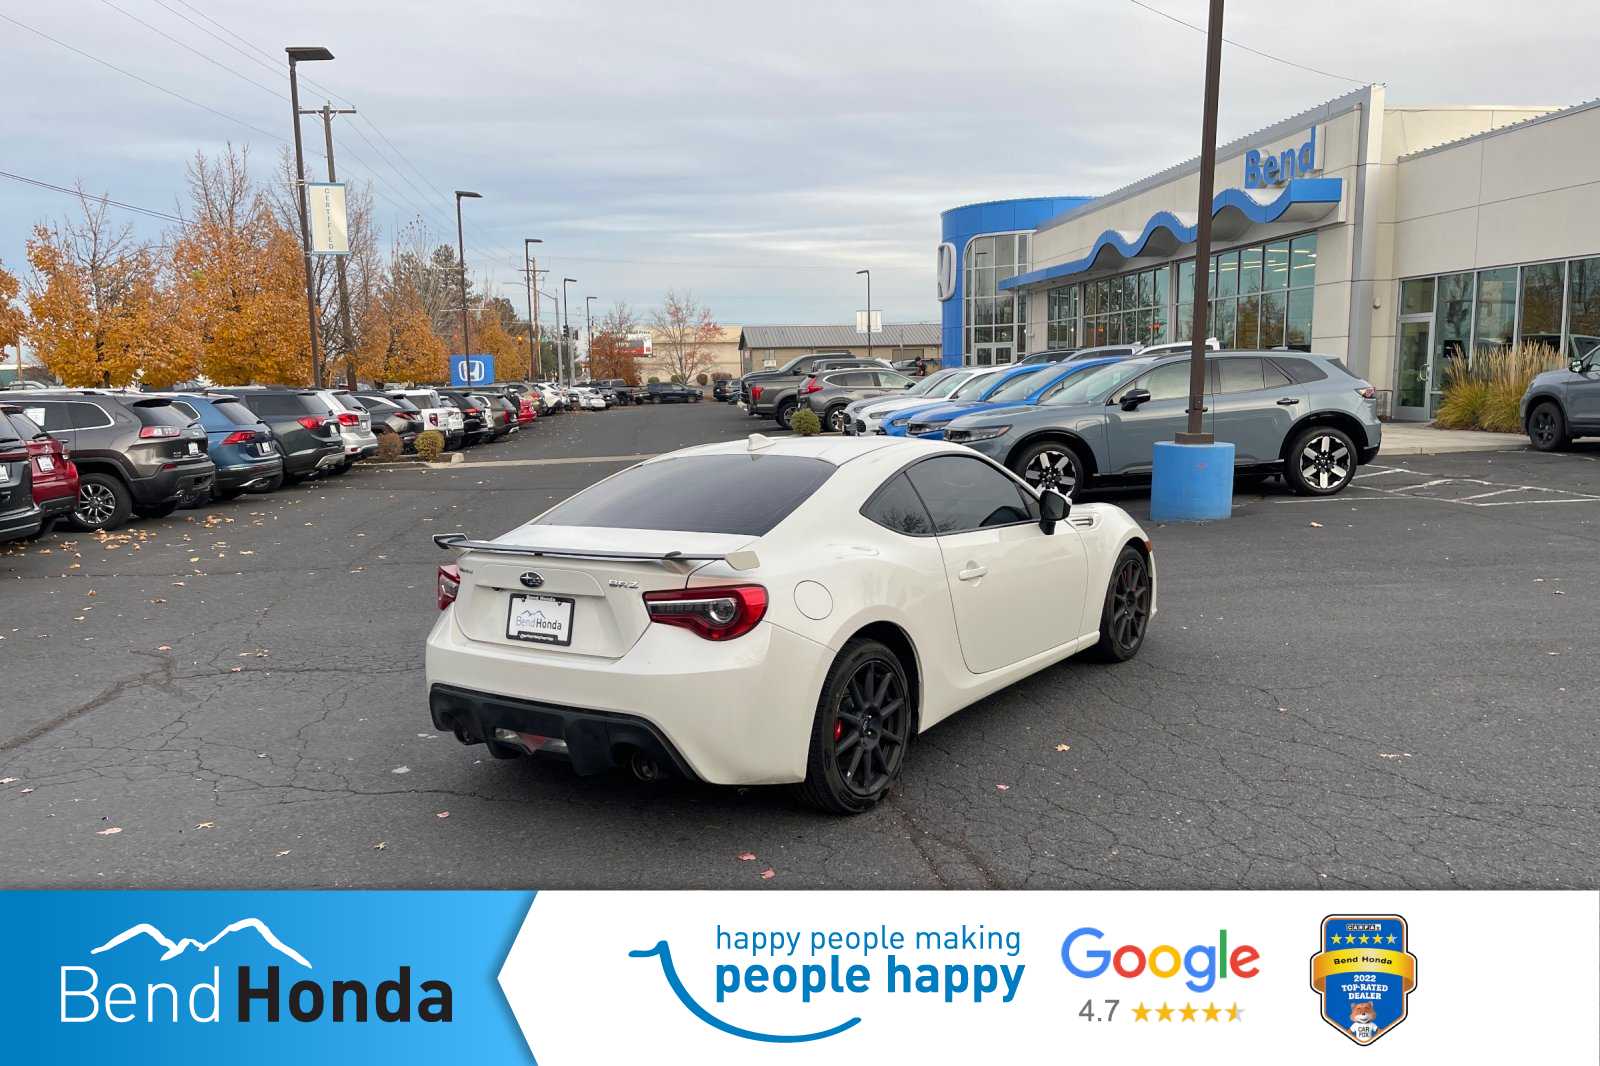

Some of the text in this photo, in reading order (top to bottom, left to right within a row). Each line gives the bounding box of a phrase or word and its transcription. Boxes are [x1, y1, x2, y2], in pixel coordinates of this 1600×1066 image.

[1245, 123, 1316, 189] Bend
[325, 188, 334, 249] CERTIFIED
[516, 615, 562, 631] Bend Honda
